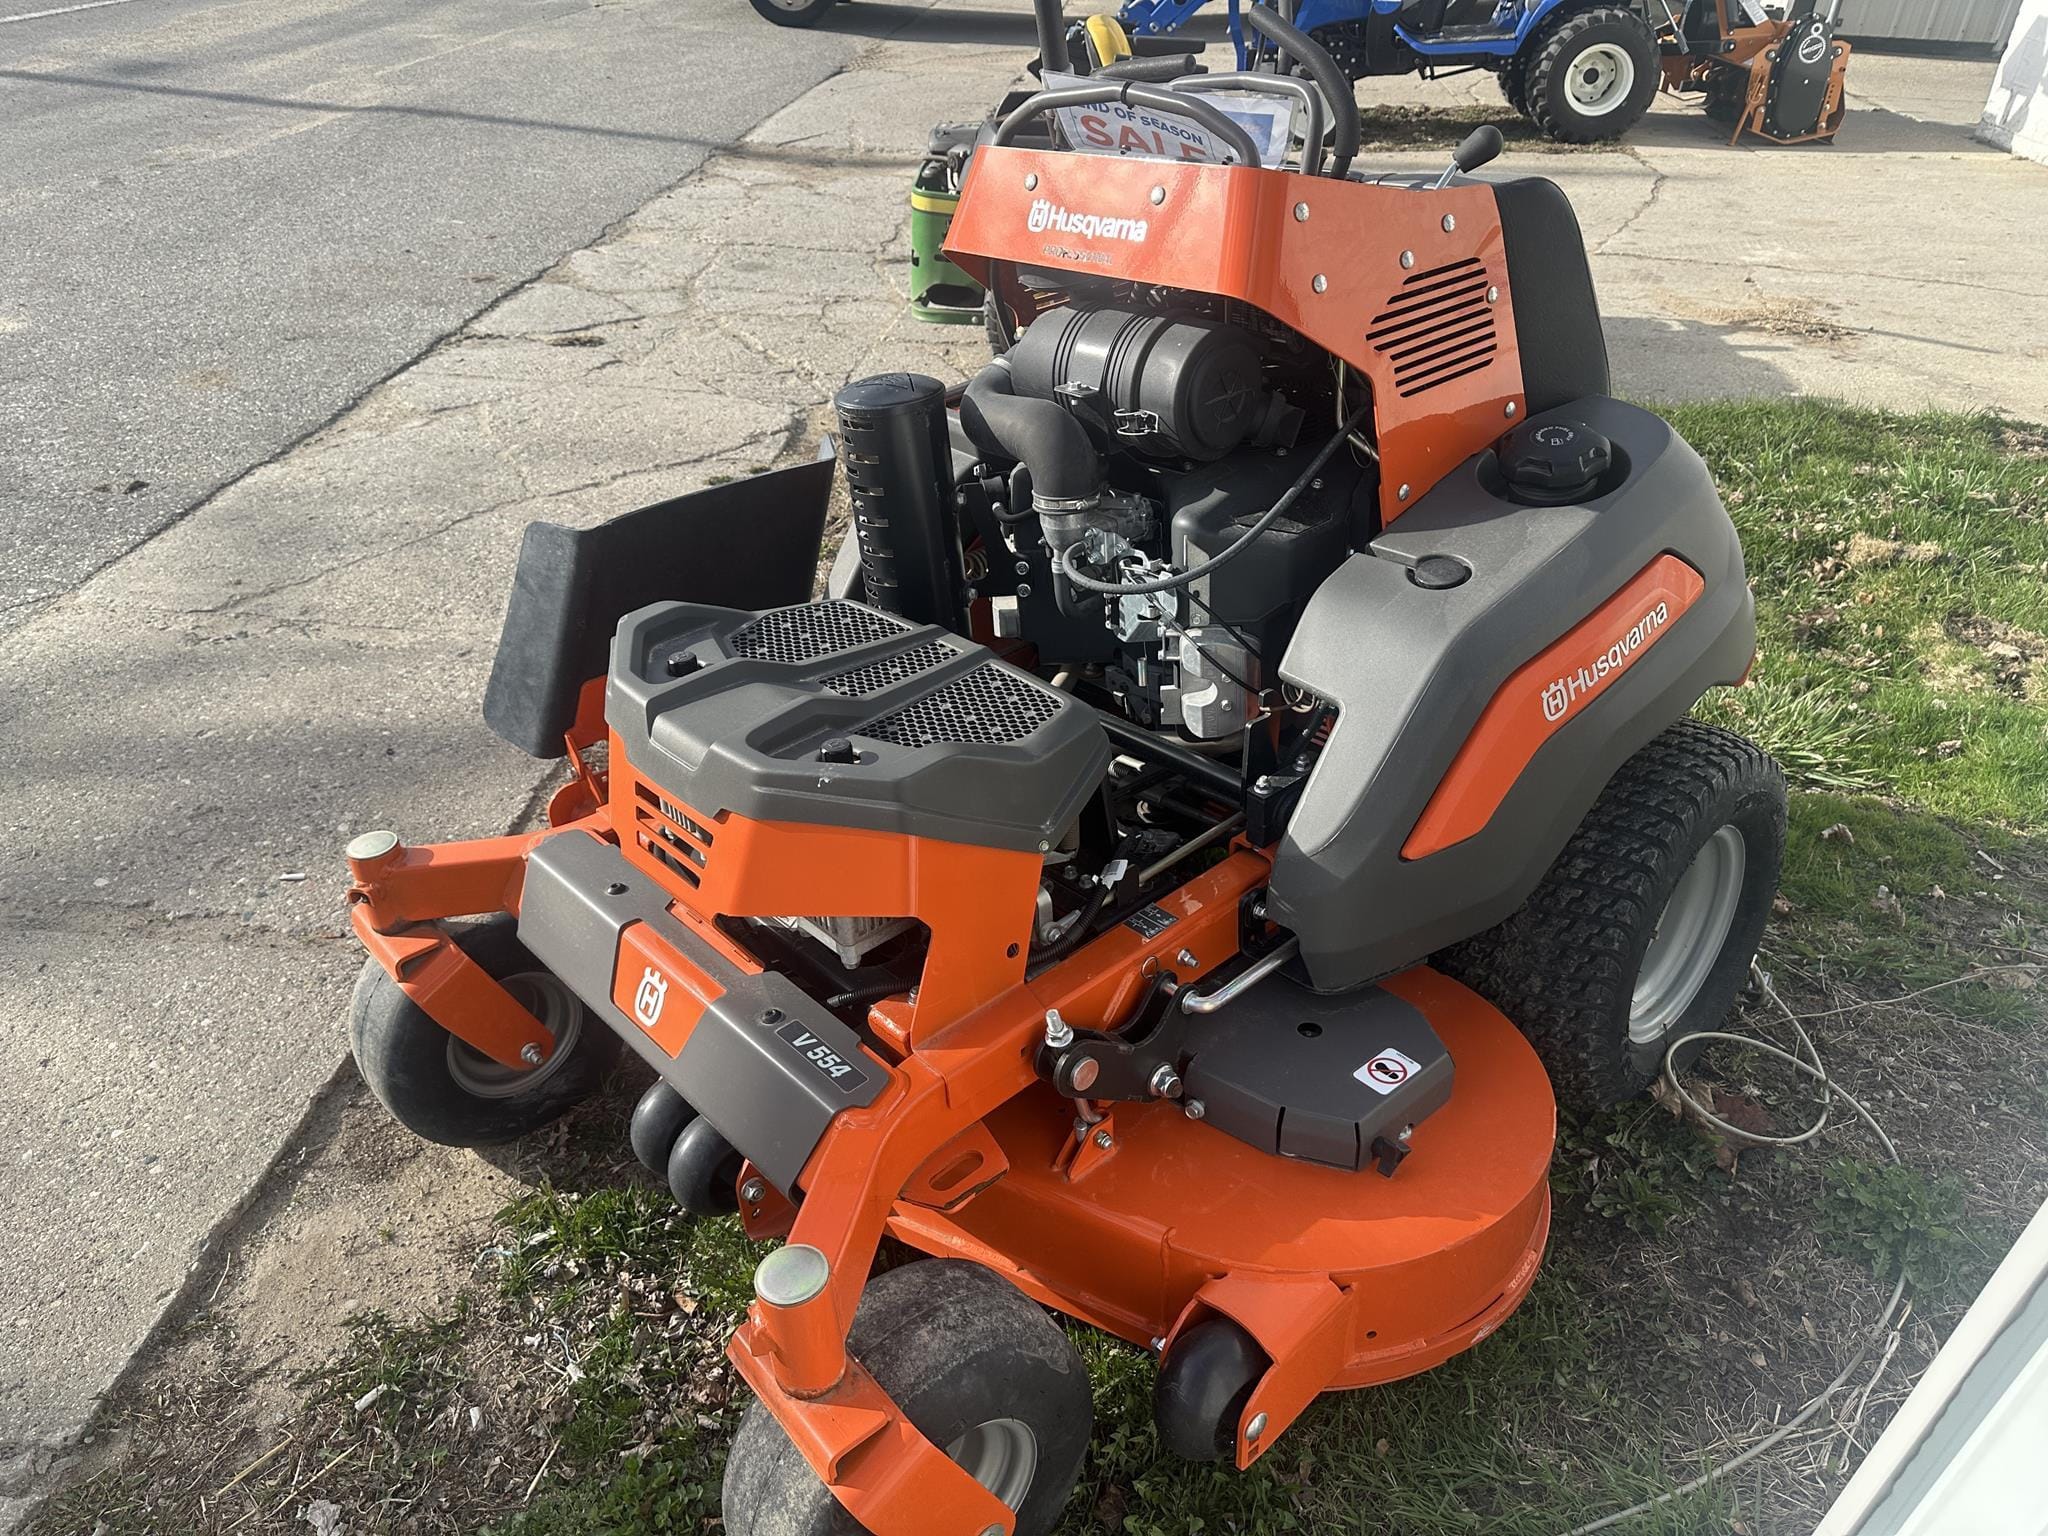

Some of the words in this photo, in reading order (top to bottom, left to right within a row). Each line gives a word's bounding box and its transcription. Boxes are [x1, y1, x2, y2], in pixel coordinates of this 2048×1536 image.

[1079, 102, 1109, 113] ND
[1115, 107, 1136, 121] OF
[1140, 116, 1204, 145] SEASON
[1047, 205, 1148, 242] Husqvarna
[1567, 602, 1668, 701] Husqvarna
[792, 1032, 818, 1047] V
[806, 1046, 852, 1078] 554
